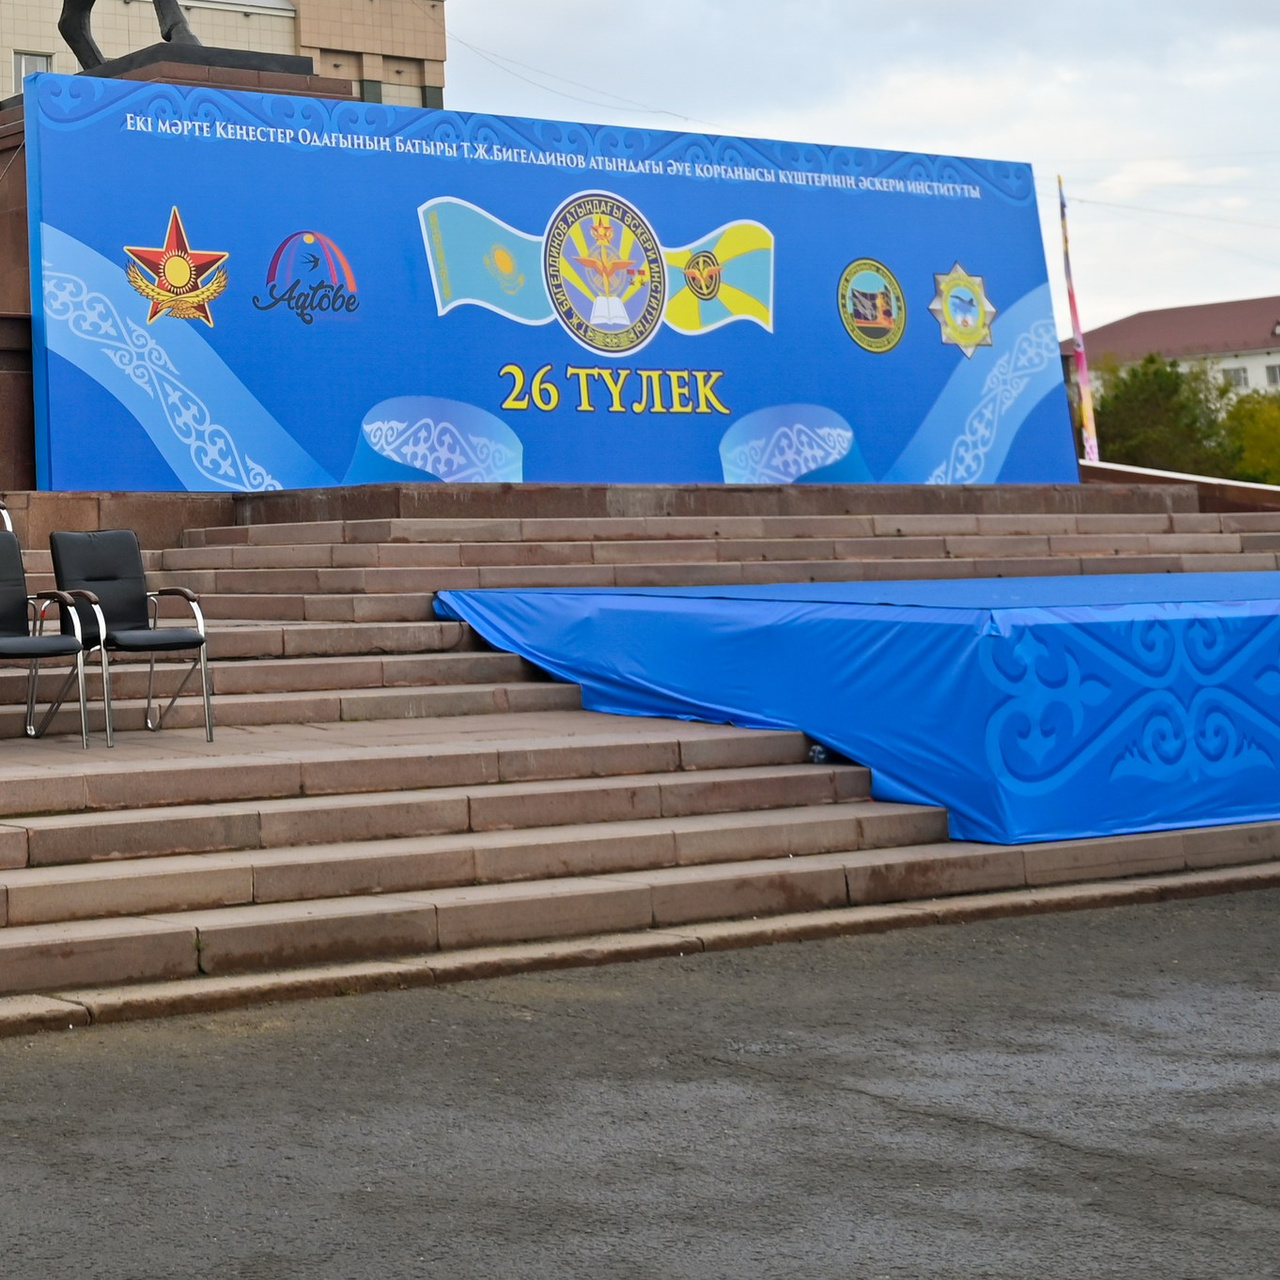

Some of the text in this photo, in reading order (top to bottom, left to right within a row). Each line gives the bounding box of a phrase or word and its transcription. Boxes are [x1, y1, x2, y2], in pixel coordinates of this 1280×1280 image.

[126, 113, 153, 132] ЕКІ
[215, 121, 295, 143] КЕҢЕСТЕР
[298, 128, 392, 153] ОДАҒЫНЫҢ
[395, 136, 458, 158] БАТЫРЫ
[588, 155, 664, 176] АТЫНДАҒЫ
[666, 159, 693, 177] ӘУЕ
[858, 176, 906, 193] ӘСКЕРИ
[907, 180, 982, 199] ИНСТИТУТЫ
[566, 200, 623, 222] АТЫНДАҒЫ
[624, 214, 654, 260] ӘСКЕРИ
[549, 222, 570, 312] БИГЕЛДИНОВ
[635, 261, 661, 338] ИНСТИТУТЫ
[498, 363, 732, 415] 26 ТҮЛЕК
